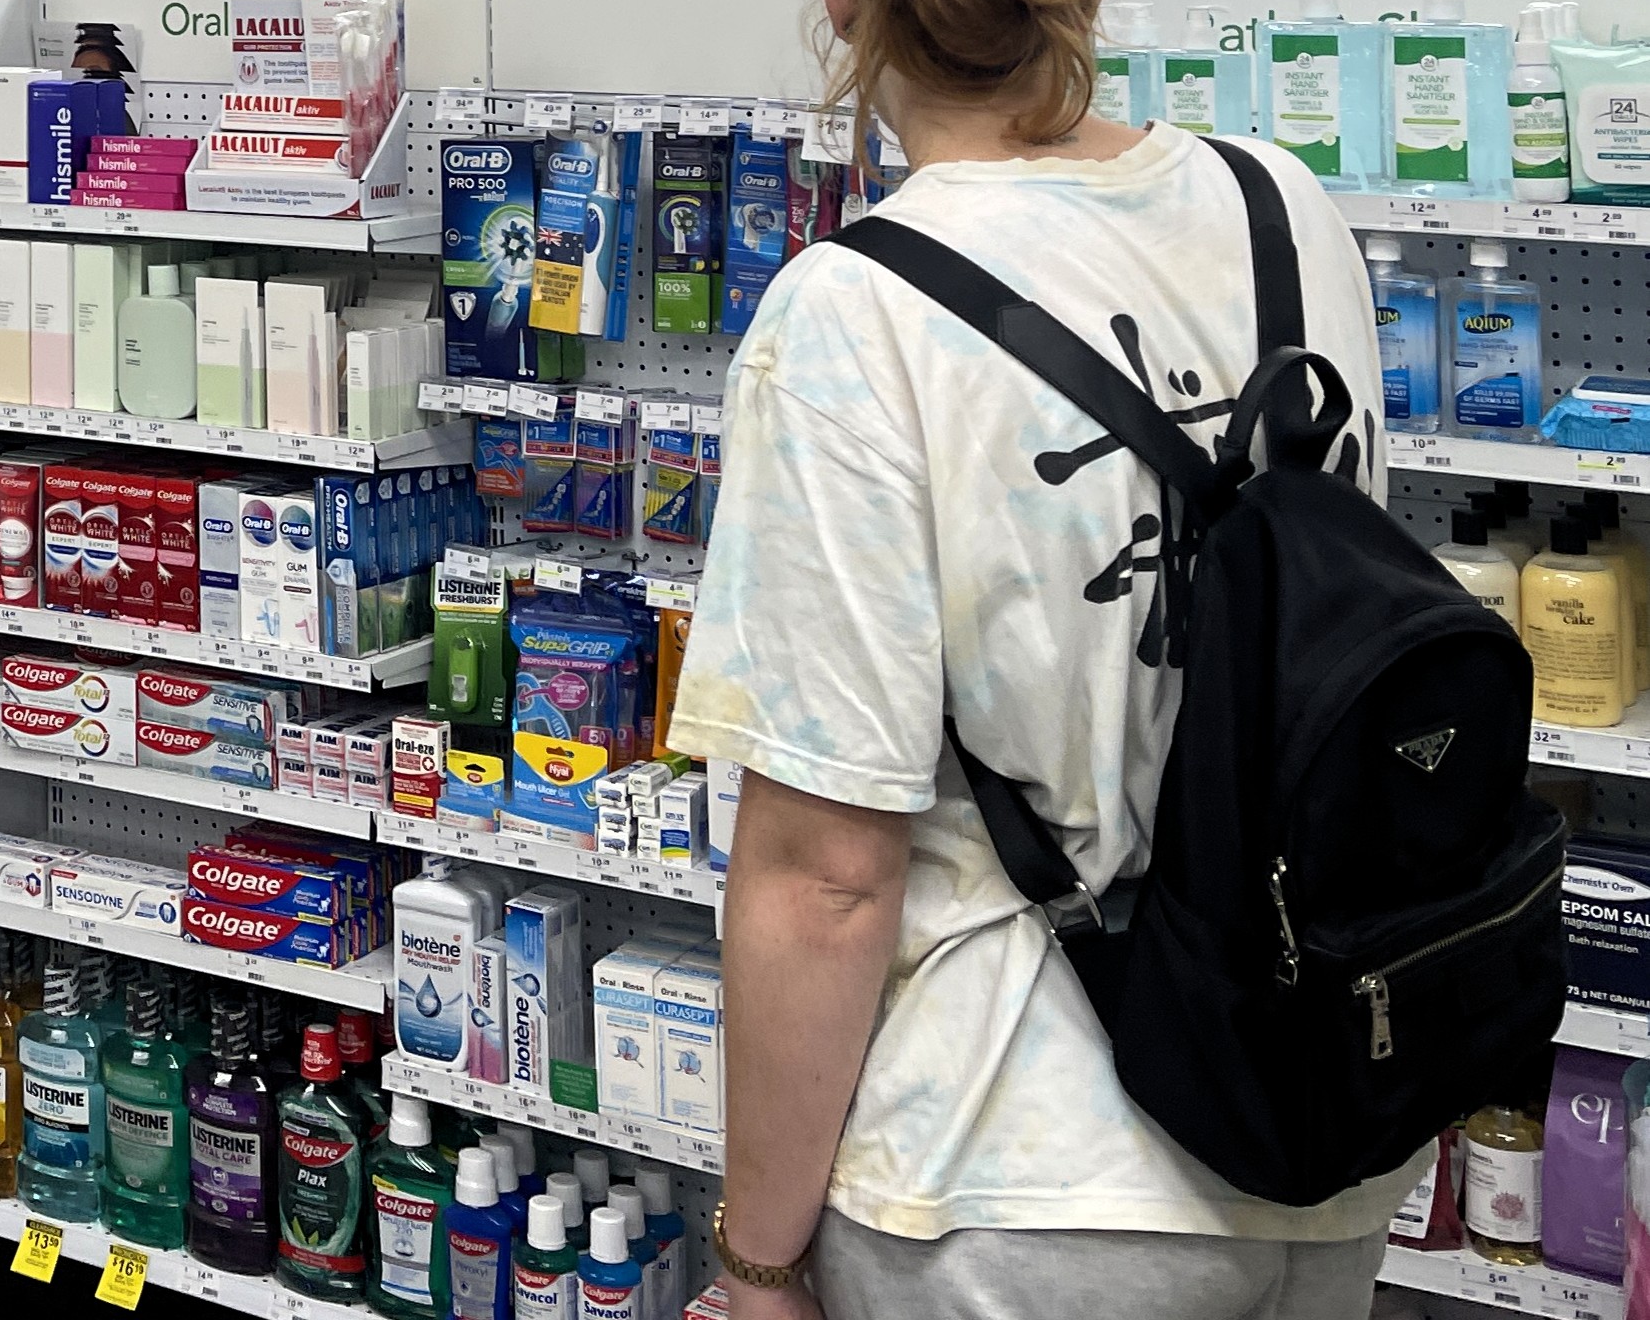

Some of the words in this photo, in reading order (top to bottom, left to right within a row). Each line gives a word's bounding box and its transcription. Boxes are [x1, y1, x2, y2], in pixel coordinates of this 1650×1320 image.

[161, 1, 230, 38] Oral
[1285, 72, 1324, 84] INSTANT
[1290, 80, 1319, 90] HAND
[1407, 75, 1450, 85] INSTANT
[1282, 88, 1330, 98] SANITISER
[1406, 92, 1455, 102] SANITISER
[1414, 84, 1444, 94] HAND
[225, 95, 294, 113] LACALUT
[296, 103, 320, 116] aktiv
[1614, 102, 1633, 115] 24
[51, 106, 72, 201] hismile
[102, 139, 141, 154] hismile
[211, 135, 282, 153] LACALUT
[284, 145, 308, 157] aktiv
[98, 156, 137, 172] hismile
[449, 151, 510, 169] Oral-B
[551, 157, 590, 173] Oral-B
[662, 164, 705, 178] Oral-B
[89, 174, 128, 190] hismile
[448, 177, 475, 190] PRO
[478, 177, 506, 190] 500
[744, 175, 778, 189] Oral-B
[82, 193, 122, 208] hismile
[658, 282, 691, 294] 100%
[1464, 315, 1513, 331] AQIUM
[46, 476, 80, 489] Colgate
[83, 481, 117, 494] Colgate
[118, 485, 153, 498] Colgate
[157, 490, 192, 503] Colgate
[50, 524, 77, 534] WHITE
[205, 521, 232, 532] Oral-B
[243, 518, 272, 530] Oral-B
[282, 524, 310, 535] Oral-B
[335, 493, 349, 550] Oral-B
[87, 529, 115, 540] WHITE
[122, 534, 151, 544] WHITE
[162, 538, 191, 550] WHITE
[438, 578, 501, 596] LISTERINE
[440, 594, 500, 605] FRESHBURST
[1551, 598, 1584, 610] vanilla
[1563, 612, 1595, 626] cake
[5, 662, 67, 684] Colgate
[73, 684, 103, 701] Total
[140, 676, 198, 699] Colgate
[213, 694, 258, 714] SENSITIVE
[3, 706, 67, 728] Colgate
[72, 730, 103, 745] Total
[281, 728, 302, 739] AIM
[139, 725, 200, 749] Colgate
[217, 743, 265, 760] SENSITIVE
[315, 734, 337, 746] AIM
[351, 741, 373, 753] AIM
[395, 738, 435, 756] Oral-eze
[192, 862, 282, 896] Colgate
[55, 886, 124, 910] SENSODYNE
[1561, 900, 1619, 922] EPSOM
[187, 906, 280, 941] Colgate
[402, 930, 461, 958] biotène
[1568, 934, 1590, 947] Bath
[1592, 940, 1639, 954] relaxation
[407, 957, 453, 974] Mouthwash
[481, 954, 493, 1009] biotène
[1590, 989, 1607, 1001] NET
[656, 1002, 714, 1023] CURASEPT
[514, 996, 530, 1083] biotène
[26, 1078, 85, 1107] LISTERINE
[38, 1097, 64, 1116] ZERO
[108, 1099, 169, 1131] LISTERINE
[127, 1122, 168, 1141] DEFENCE
[192, 1120, 256, 1155] LISTERINE
[195, 1144, 220, 1161] TOTAL
[222, 1148, 252, 1165] CARE
[284, 1134, 341, 1160] Colgate
[298, 1169, 327, 1189] Plax
[376, 1195, 433, 1218] Colgate
[450, 1234, 491, 1254] Colgate
[455, 1260, 489, 1278] Peroxyl
[584, 1283, 625, 1301] Colgate
